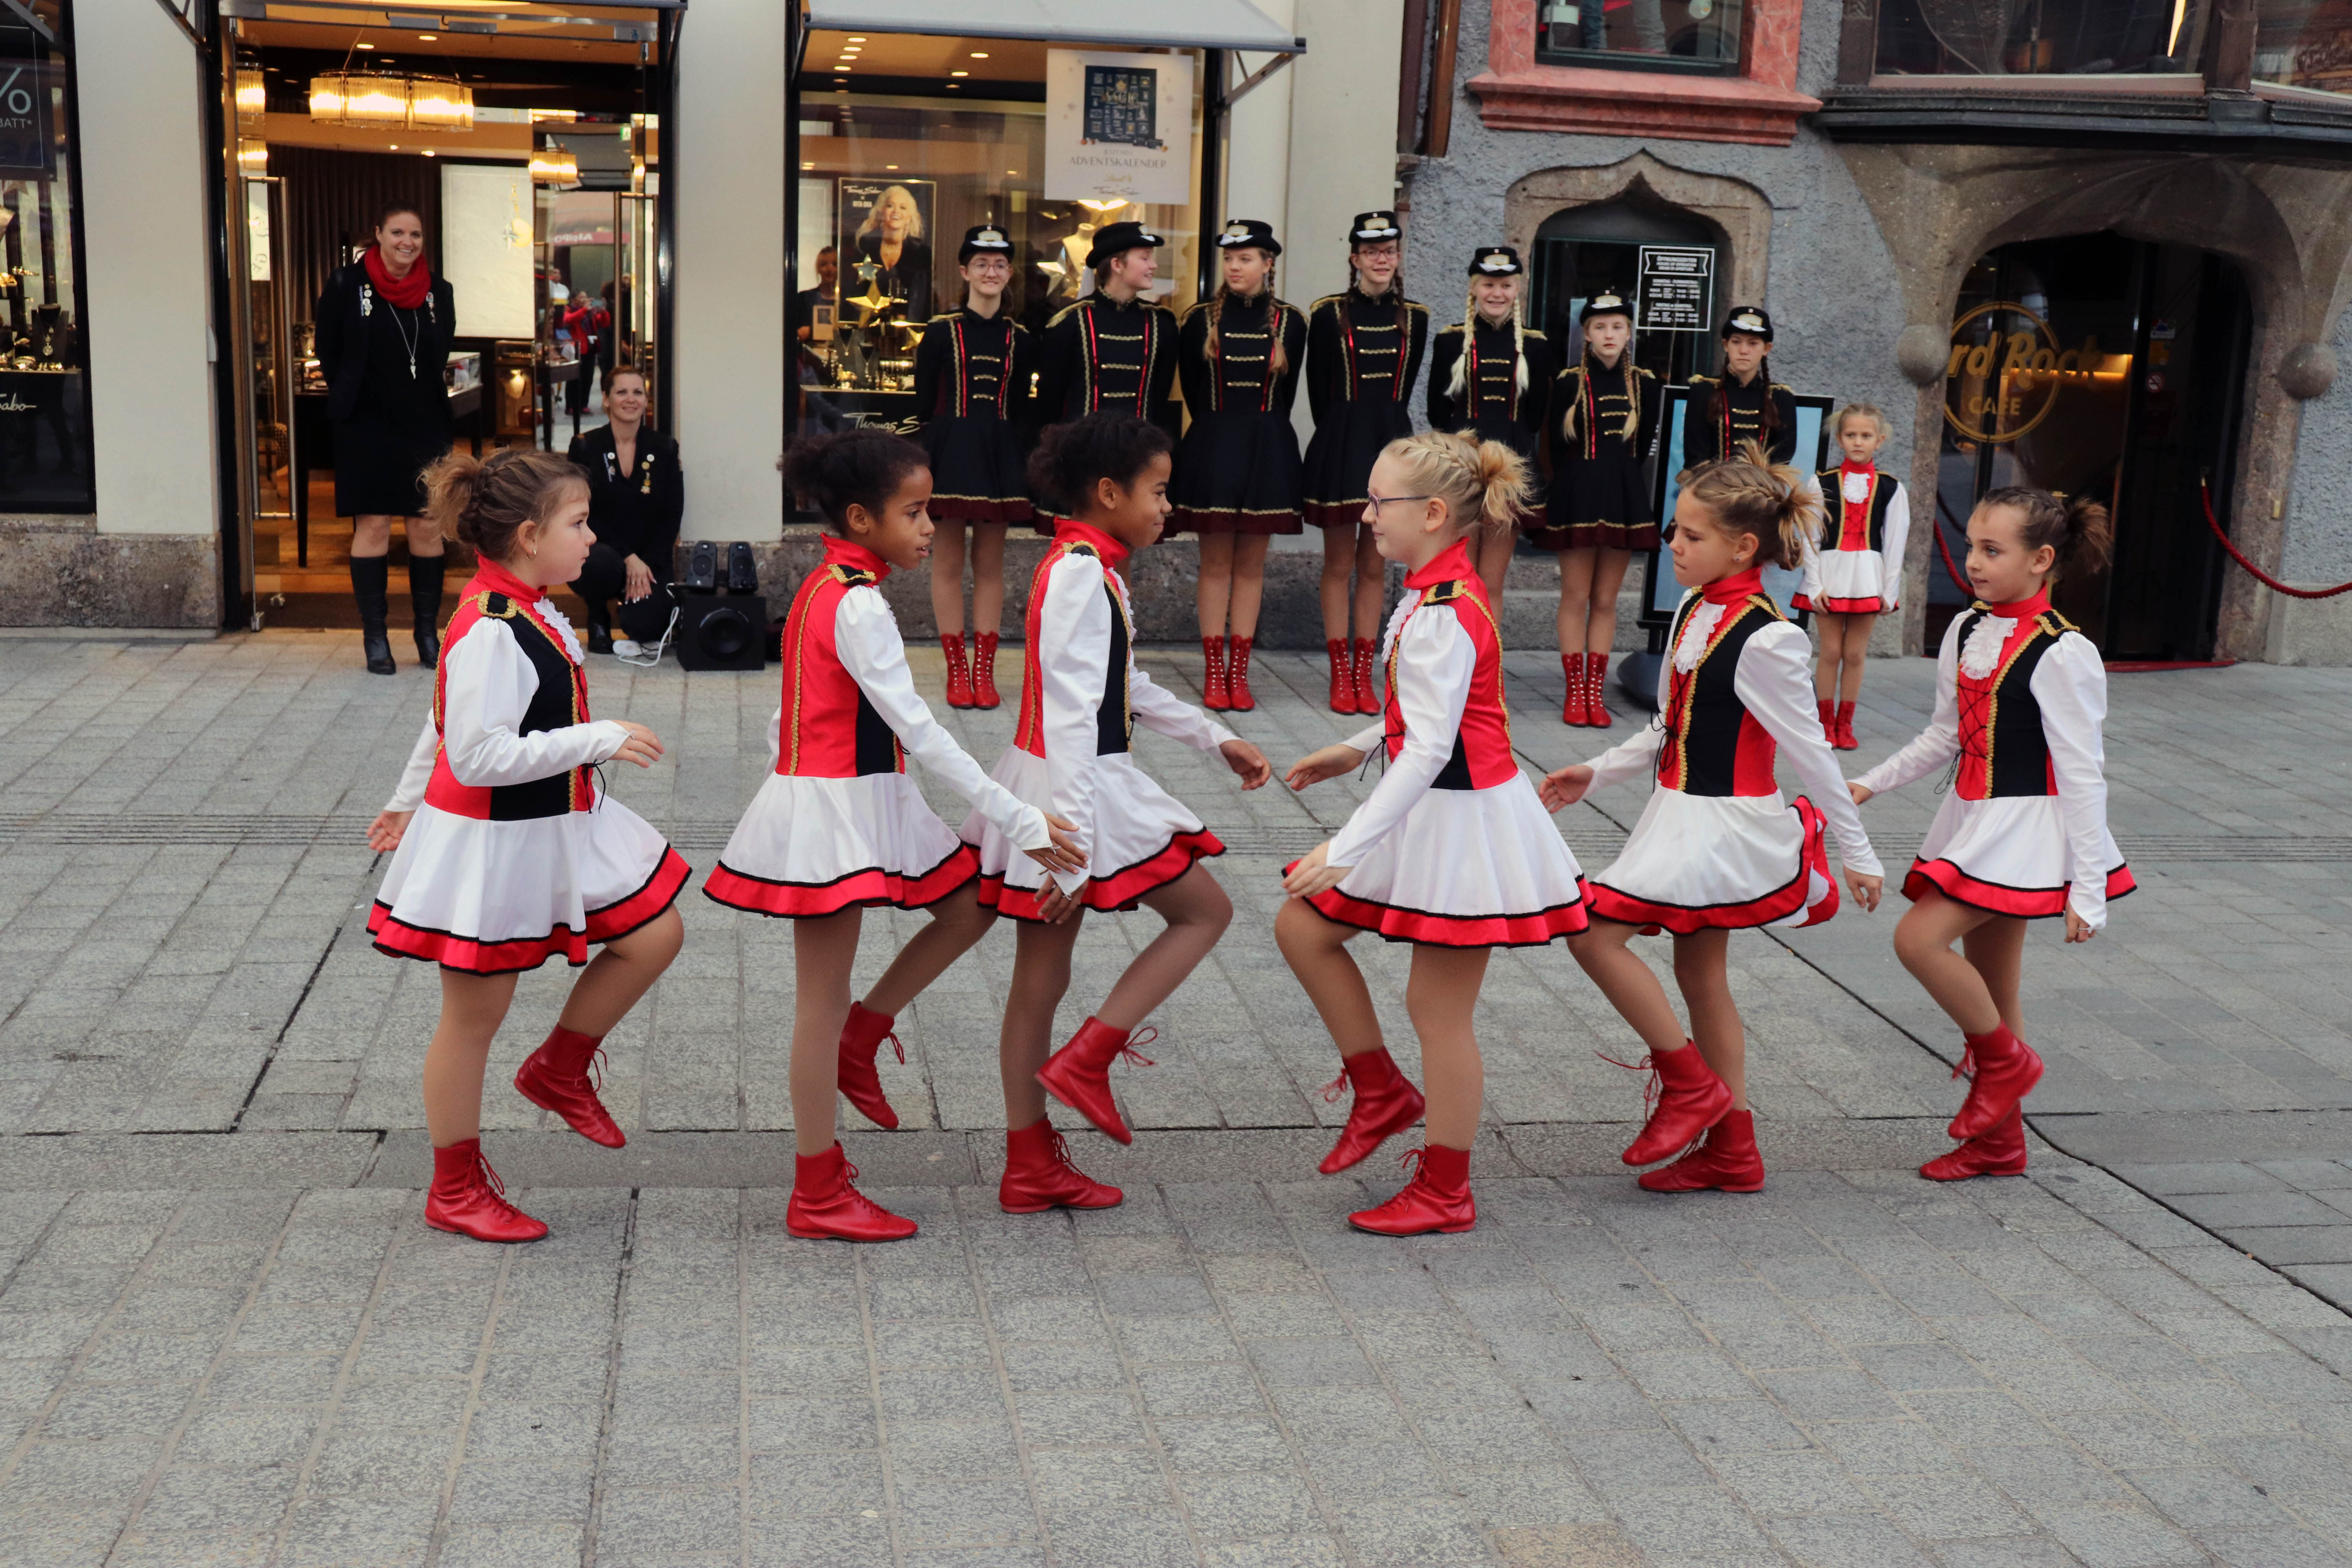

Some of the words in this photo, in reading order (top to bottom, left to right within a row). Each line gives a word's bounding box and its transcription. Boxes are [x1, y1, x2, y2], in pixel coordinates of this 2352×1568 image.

[1069, 156, 1167, 168] ADVENTSKALENDER
[1947, 331, 2002, 379] rd
[1969, 395, 2022, 416] CAFE
[842, 412, 898, 432] Thomas
